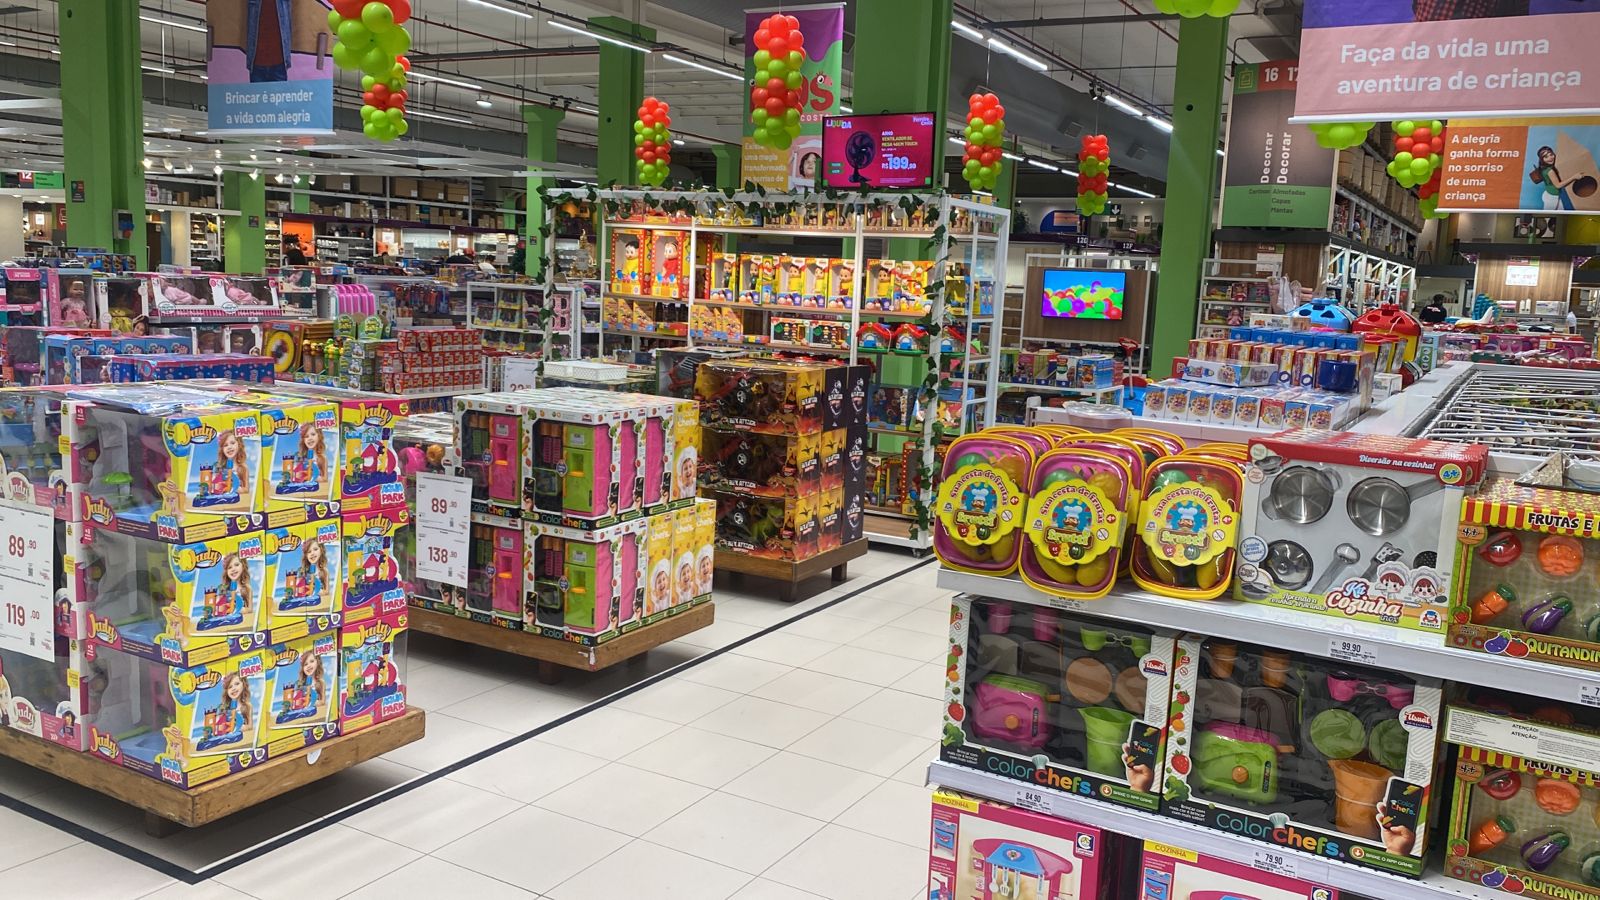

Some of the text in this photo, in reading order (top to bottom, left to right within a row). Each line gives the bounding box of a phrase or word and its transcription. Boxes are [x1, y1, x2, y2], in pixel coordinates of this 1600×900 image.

[1340, 37, 1550, 65] Faça da vida uma
[1265, 66, 1299, 82] 16 17
[1337, 67, 1582, 95] aventura de criança
[225, 89, 314, 106] Brincar é aprender
[226, 110, 311, 126] a vida com alegria
[1451, 134, 1501, 146] A alegria
[1261, 132, 1274, 184] Decorar
[1276, 131, 1292, 184] Decorar
[1449, 149, 1519, 160] ganha forma
[1448, 163, 1504, 172] no sorriso
[1446, 177, 1486, 187] de uma
[1445, 191, 1486, 203] criança
[354, 402, 392, 427] Judy
[235, 425, 258, 437] PARK
[316, 418, 336, 429] PARK
[1359, 454, 1436, 470] Diversão na cozinha!
[962, 468, 983, 484] cesta
[984, 468, 995, 480] de
[993, 475, 1009, 506] frutas
[381, 491, 405, 505] PARK
[431, 497, 447, 514] 89
[1040, 485, 1105, 524] Sua cesta de frutas
[83, 495, 114, 526] Judy
[1153, 487, 1221, 526] Sua cesta de frutas
[356, 513, 392, 537] Judy
[1527, 512, 1593, 530] FRUTAS E
[159, 525, 179, 539] PARK
[318, 532, 338, 543] PARK
[1462, 527, 1479, 537] 4+
[9, 534, 25, 558] 89
[240, 547, 262, 558] PARK
[427, 546, 448, 564] 138
[383, 598, 406, 612] PARK
[1326, 592, 1402, 617] Cozinha
[6, 602, 25, 627] 119
[88, 618, 119, 645] Judy
[356, 619, 392, 648] Judy
[161, 649, 182, 663] PARK
[314, 643, 336, 655] PARK
[240, 665, 262, 677] PARK
[382, 703, 405, 717] PARK
[1405, 711, 1431, 725] Usual
[1511, 723, 1539, 733] ATENÇÃO!
[1511, 730, 1538, 740] ATENÇÃO!
[91, 727, 119, 759] Judy
[987, 756, 1034, 778] Color
[1460, 764, 1476, 773] 4+
[1523, 758, 1573, 776] FRUTAS
[162, 769, 183, 783] PARK
[942, 797, 969, 809] COZINHA
[1216, 813, 1272, 838] Color
[1155, 844, 1187, 857] COZINHA
